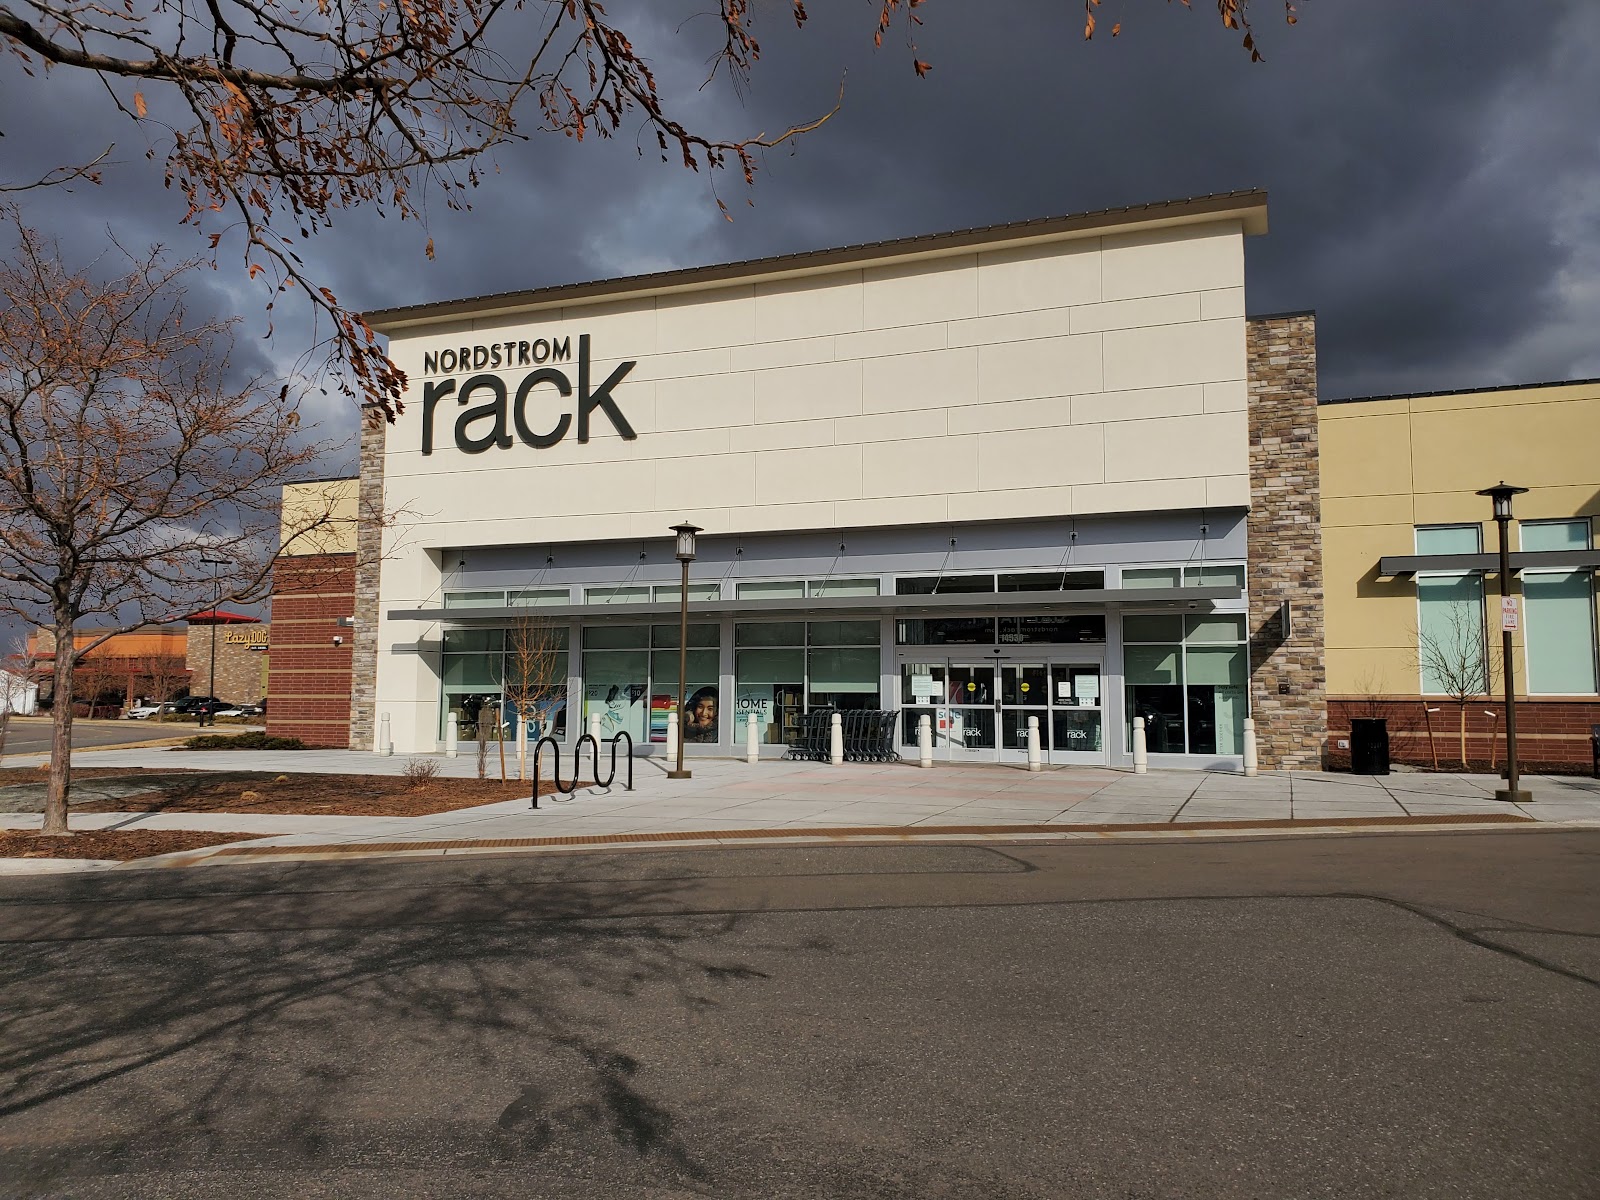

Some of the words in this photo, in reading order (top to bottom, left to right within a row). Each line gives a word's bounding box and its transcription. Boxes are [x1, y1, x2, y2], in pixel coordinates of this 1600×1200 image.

[424, 335, 571, 375] NORDSTROM
[421, 333, 637, 456] rack
[226, 631, 250, 650] Lazy
[251, 631, 267, 643] DOG
[631, 689, 641, 697] $10
[963, 728, 982, 737] rack
[1016, 730, 1029, 738] rac
[1067, 730, 1087, 739] rack
